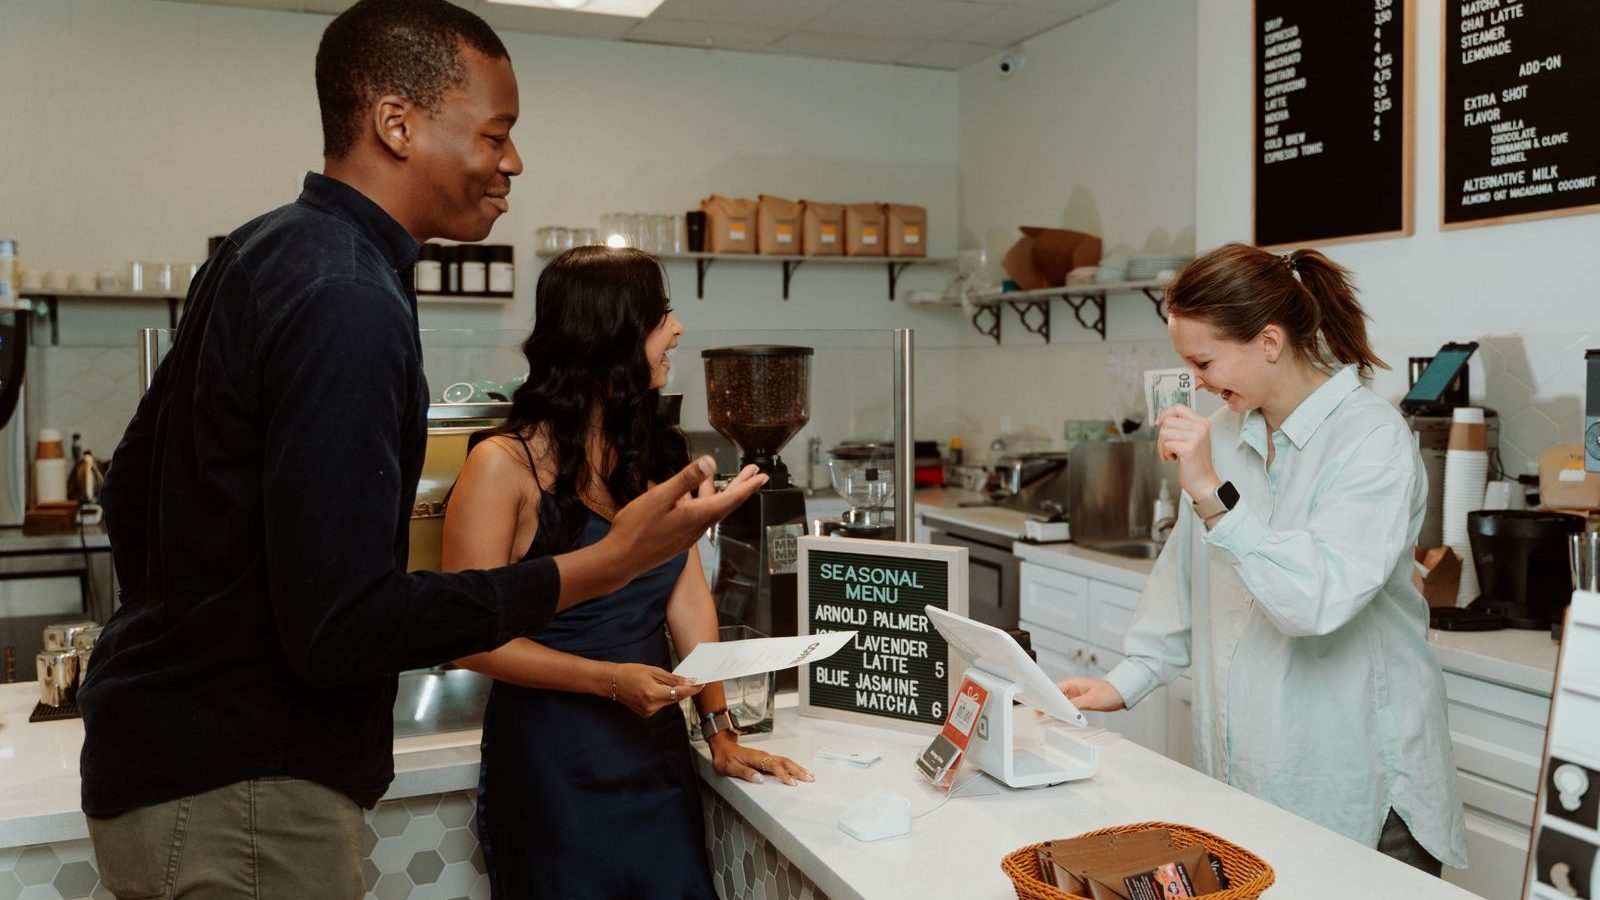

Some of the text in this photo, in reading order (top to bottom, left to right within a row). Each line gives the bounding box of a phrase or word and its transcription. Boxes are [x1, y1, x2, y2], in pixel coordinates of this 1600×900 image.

[1460, 0, 1500, 18] MATCHA
[1460, 3, 1524, 33] CHAI LATTE
[1264, 25, 1299, 46] ESPRESSO
[1460, 26, 1506, 49] STEAMER
[1462, 40, 1512, 65] LEMONADE
[1518, 54, 1562, 78] ADD-ON
[1264, 96, 1287, 112] LATTE
[1463, 85, 1529, 112] EXTRA SHOT
[1463, 107, 1501, 127] FLAVOR
[1490, 119, 1525, 135] VANILLA
[1263, 136, 1284, 151] COLD
[1285, 132, 1307, 147] BREW
[1264, 129, 1381, 164] ESPRESSO TONIC 5
[1490, 126, 1537, 146] CHOCOLATE
[1490, 138, 1532, 156] CINNAMON
[1541, 131, 1569, 147] CLOVE
[1490, 151, 1527, 167] CARAMEL
[1461, 175, 1597, 206] ALMOND OAT MACADAMIA COCONUT
[1462, 165, 1559, 193] ALTERNATIVE MILK
[1179, 373, 1191, 388] 50
[820, 563, 924, 589] SEASONAL
[845, 583, 899, 604] MENU
[815, 604, 929, 633] ARNOLD PALMER
[854, 634, 929, 659] LAVENDER
[863, 652, 945, 679] LATTE 5
[816, 666, 919, 697] BLUE JASMINE
[856, 690, 919, 716] MATCHA
[931, 701, 942, 718] 6
